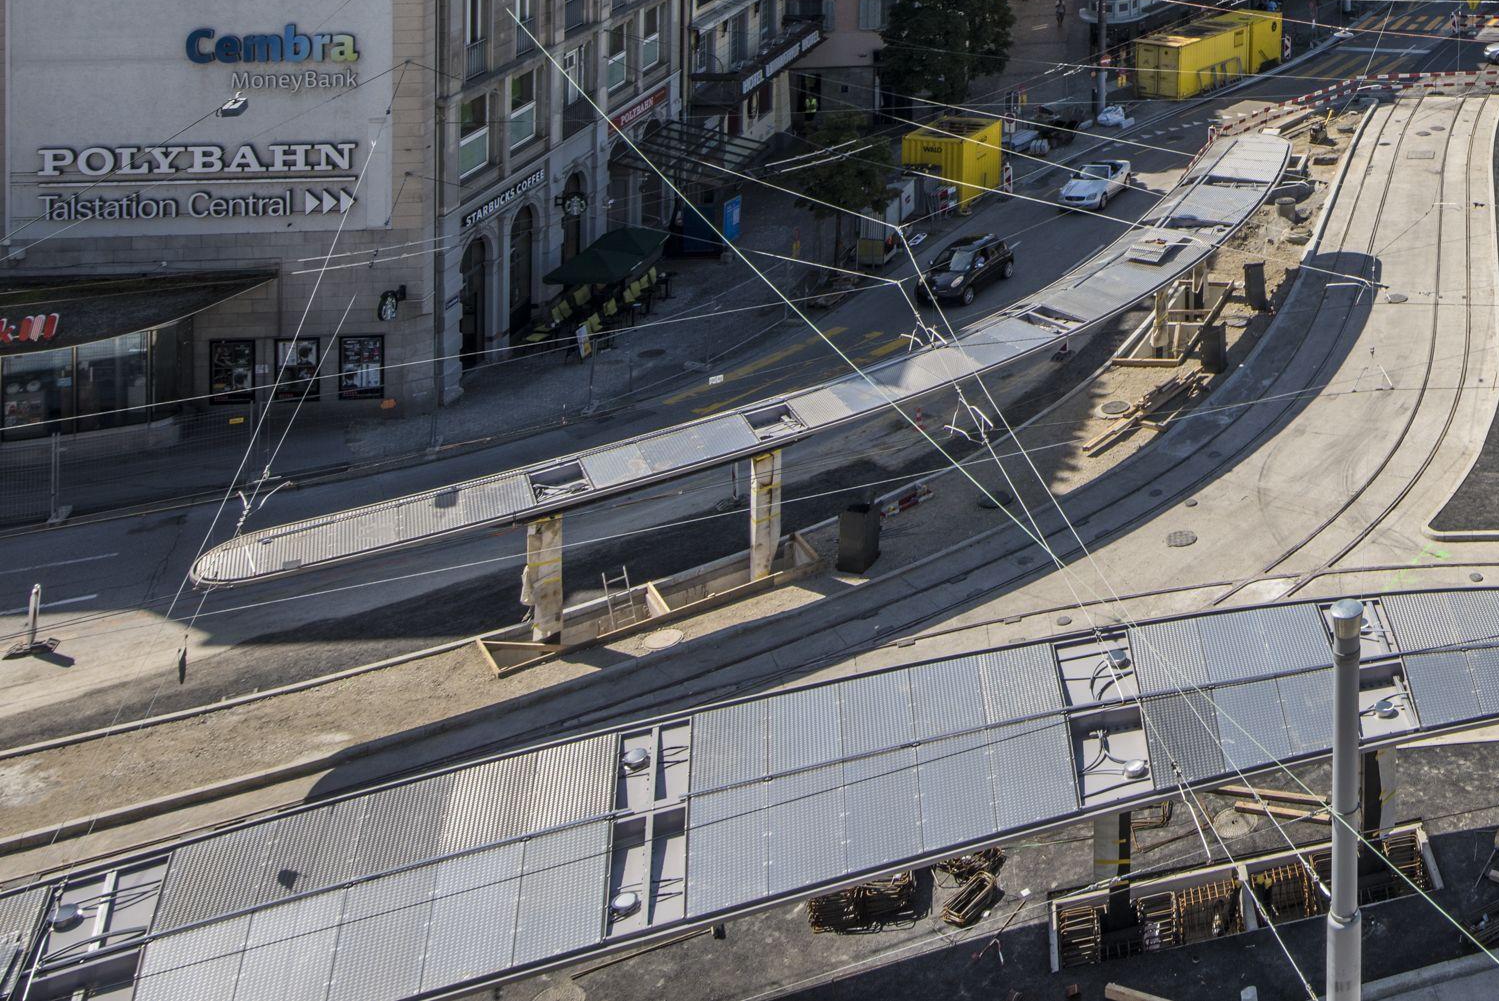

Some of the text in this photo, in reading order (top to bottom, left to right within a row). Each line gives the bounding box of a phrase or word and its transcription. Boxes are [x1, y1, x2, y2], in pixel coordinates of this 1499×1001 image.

[184, 23, 361, 64] Cembra
[230, 68, 359, 94] MoneyBank
[619, 96, 655, 126] POLYBAHN
[37, 142, 359, 178] POLYBAHN
[37, 188, 294, 222] Talstation Central
[465, 169, 545, 228] STARBUCKS COFFEE
